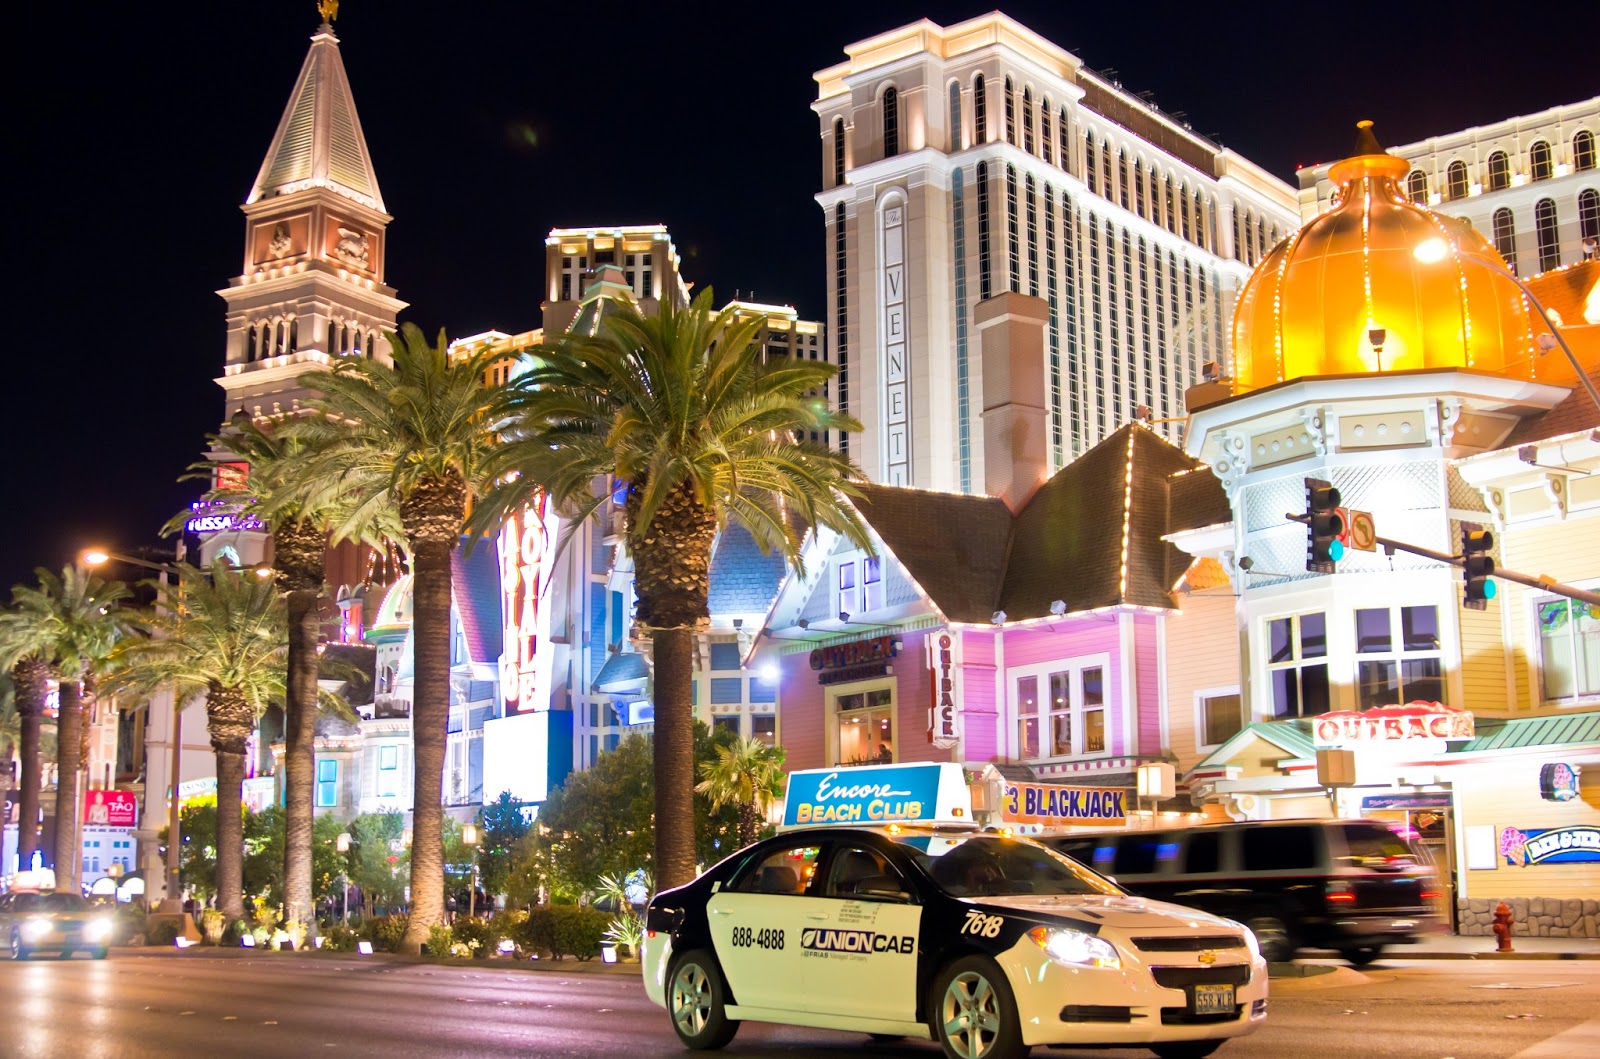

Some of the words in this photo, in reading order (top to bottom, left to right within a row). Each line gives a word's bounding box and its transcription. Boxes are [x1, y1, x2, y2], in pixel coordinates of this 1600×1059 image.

[886, 211, 901, 225] The
[810, 635, 895, 670] OUTBACK
[939, 634, 954, 736] OUTBACK
[1317, 712, 1475, 742] OUTBACK
[816, 773, 911, 801] Encore
[108, 802, 133, 812] TAO
[797, 802, 861, 822] BEACH
[867, 799, 921, 820] CLUB
[1025, 787, 1125, 818] BLACKJACK
[732, 926, 785, 950] 888-4888
[960, 912, 1004, 938] 7618
[809, 951, 829, 959] FRIAS
